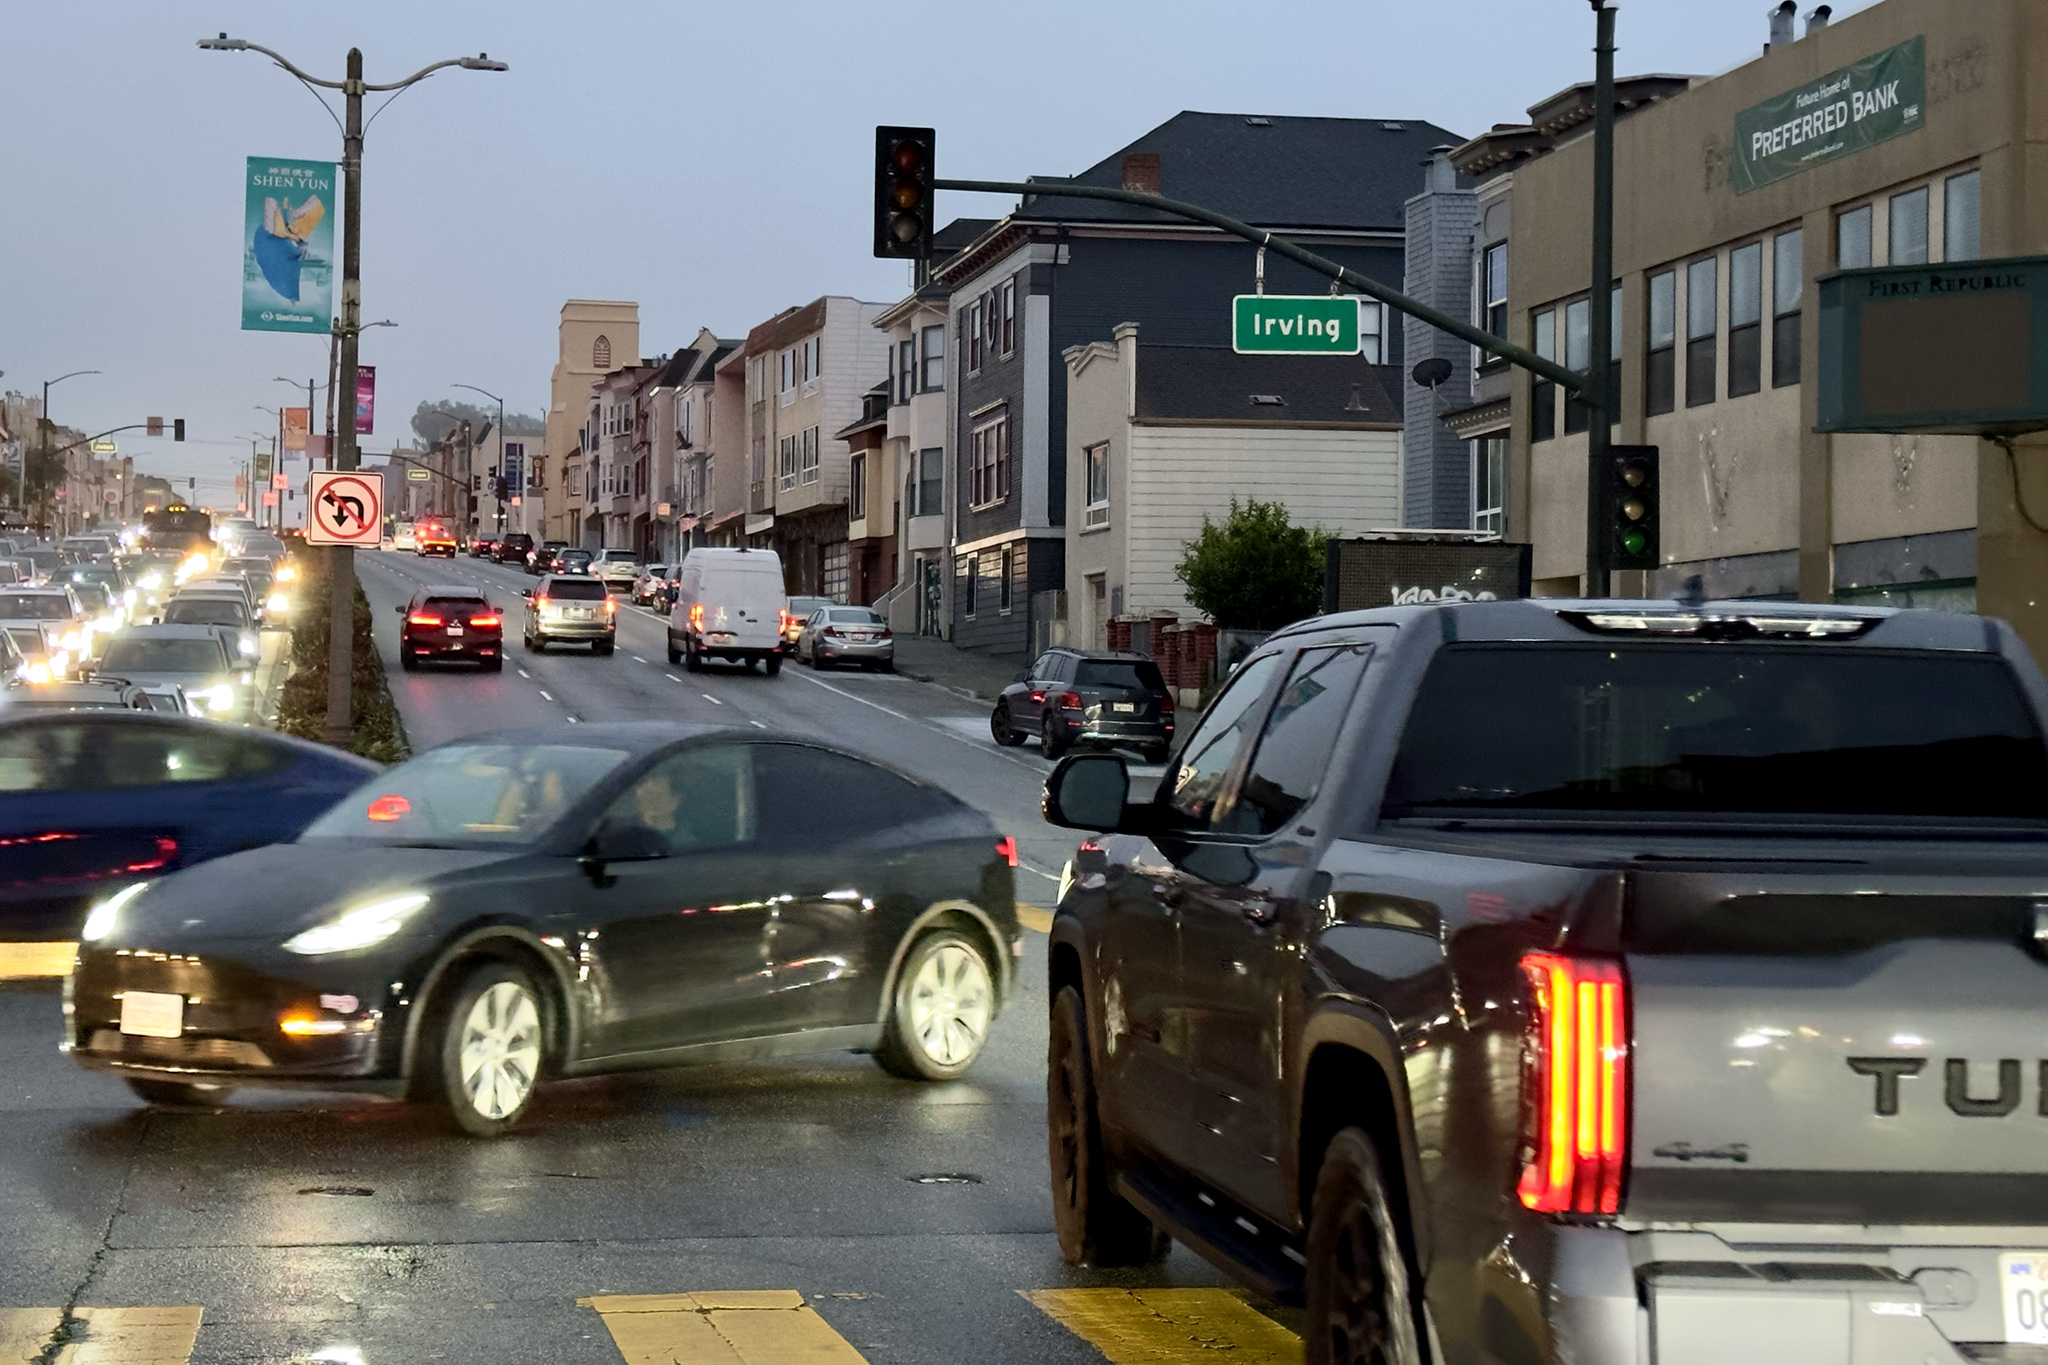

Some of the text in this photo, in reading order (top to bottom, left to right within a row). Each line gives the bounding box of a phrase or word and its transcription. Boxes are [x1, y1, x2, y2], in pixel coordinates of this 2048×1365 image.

[1796, 92, 1820, 109] Future
[1820, 81, 1840, 99] Home
[1752, 101, 1848, 161] PREFERRED
[1852, 79, 1900, 122] BANK
[253, 175, 329, 190] SHEN YUN
[1868, 273, 2026, 297] FIRST REPUBLIC
[1254, 313, 1340, 343] Irving
[1846, 1056, 2048, 1118] TU
